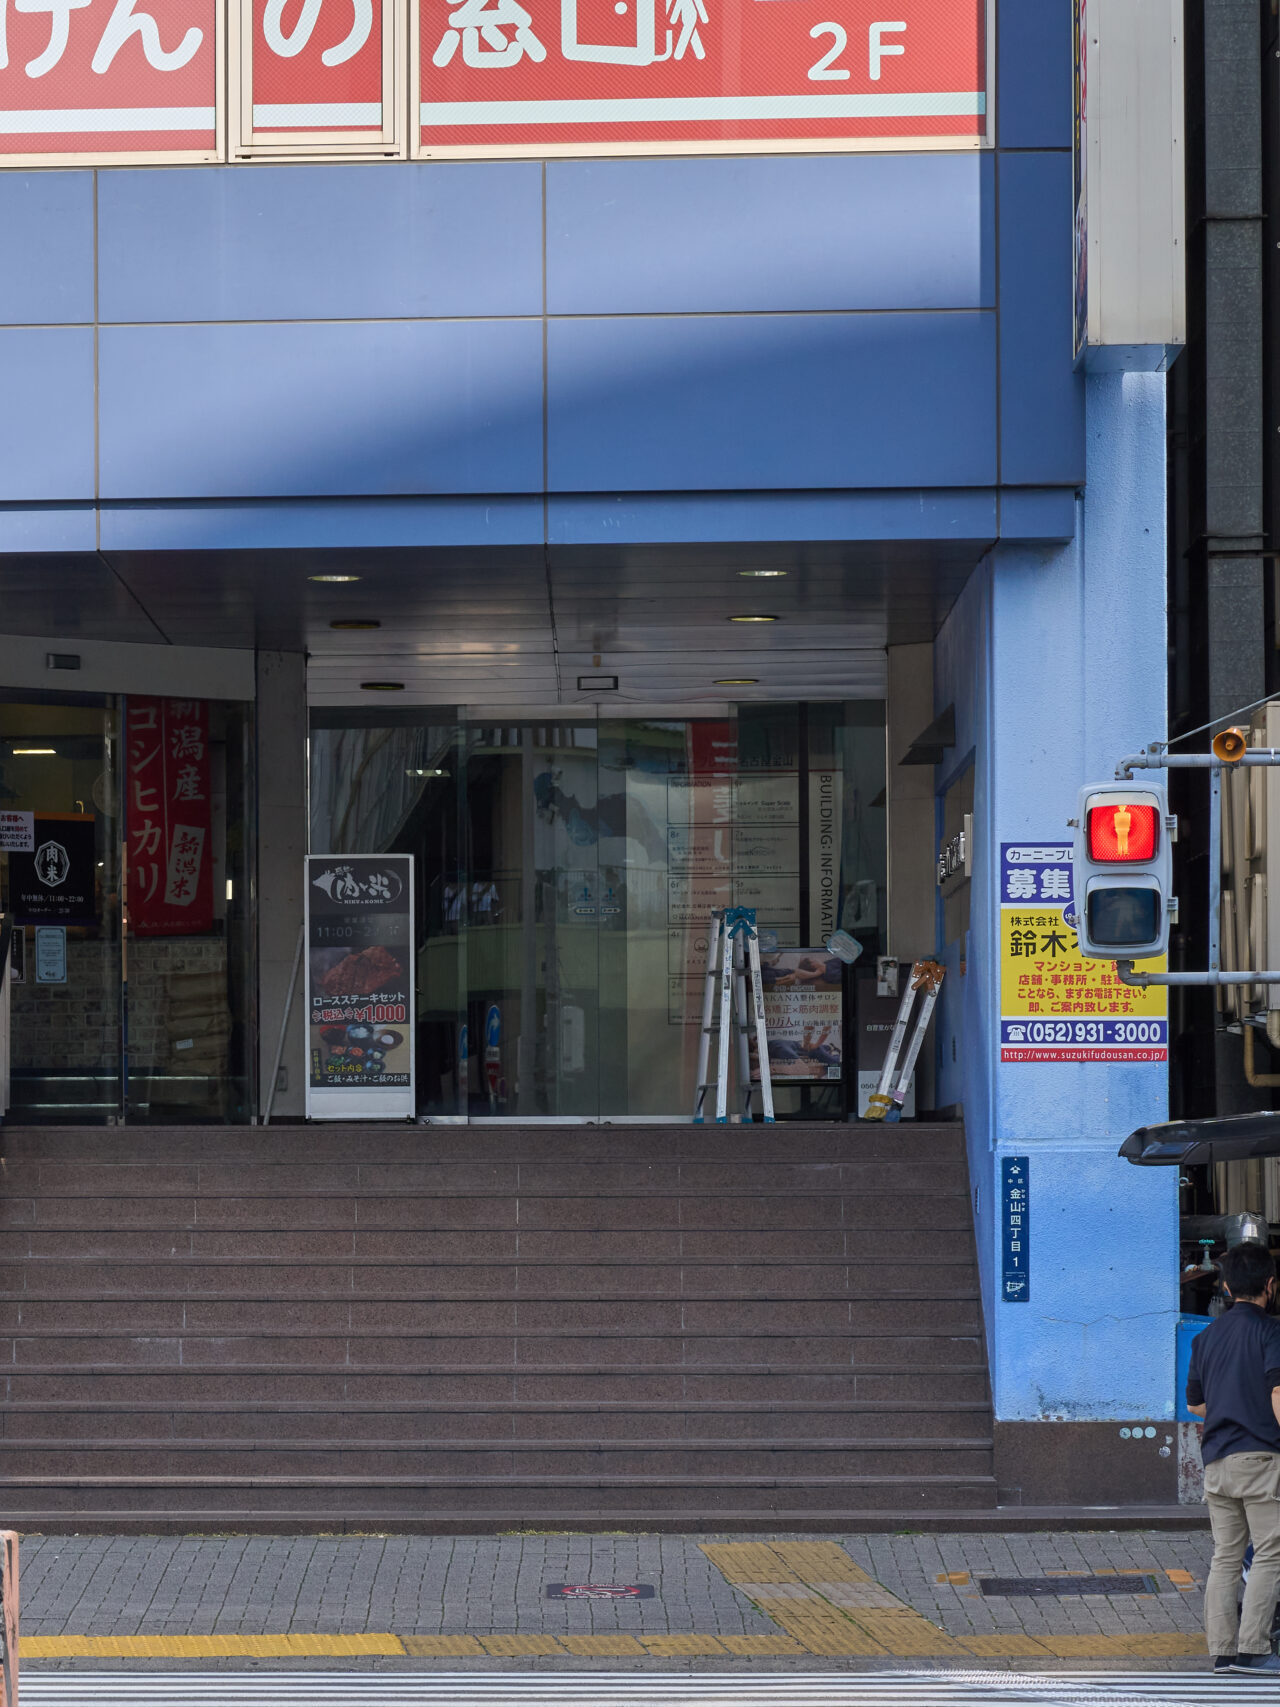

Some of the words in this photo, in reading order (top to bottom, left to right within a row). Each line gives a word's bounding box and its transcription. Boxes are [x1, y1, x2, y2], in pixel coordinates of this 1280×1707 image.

[807, 20, 908, 81] 2F
[128, 706, 163, 904] コシヒカリ
[1006, 868, 1071, 899] 募集
[1010, 916, 1060, 927] 株式会社
[312, 992, 406, 1007] ロースステーキセット
[1017, 988, 1148, 1000] ことなら、まずお電話下さい。
[322, 1008, 345, 1021] 税込
[354, 1004, 407, 1023] ¥1,000
[1028, 1001, 1136, 1013] 即、ご案内致します。
[1026, 1022, 1162, 1043] (052)931-3000
[1003, 1050, 1165, 1061] http://www.suzukifudousan.co.jp/
